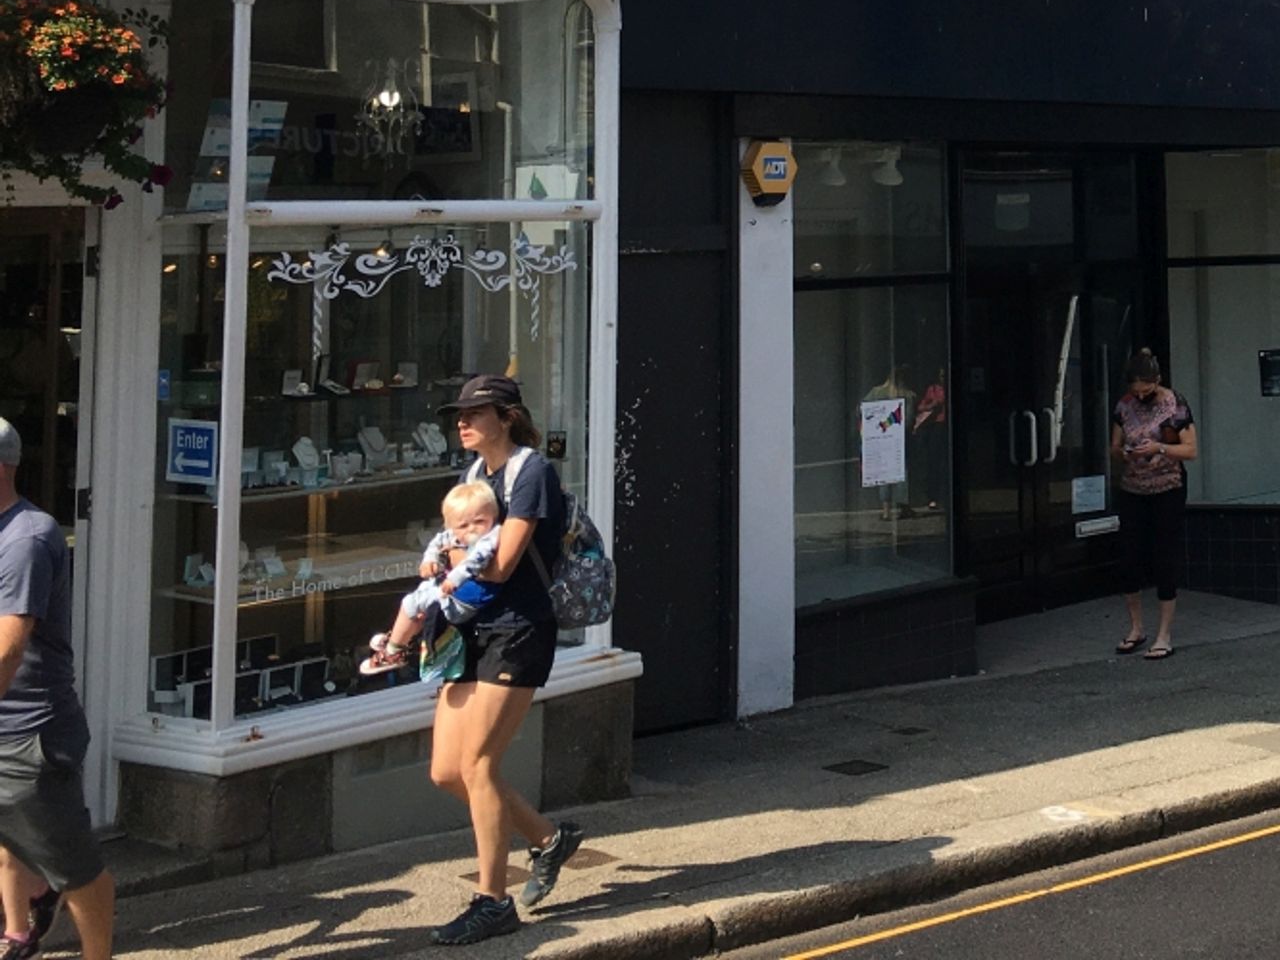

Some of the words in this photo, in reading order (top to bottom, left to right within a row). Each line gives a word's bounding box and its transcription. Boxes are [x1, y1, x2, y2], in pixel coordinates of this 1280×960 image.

[764, 160, 787, 176] ADT
[176, 429, 209, 449] Enter
[252, 584, 285, 602] The
[292, 577, 342, 597] Home
